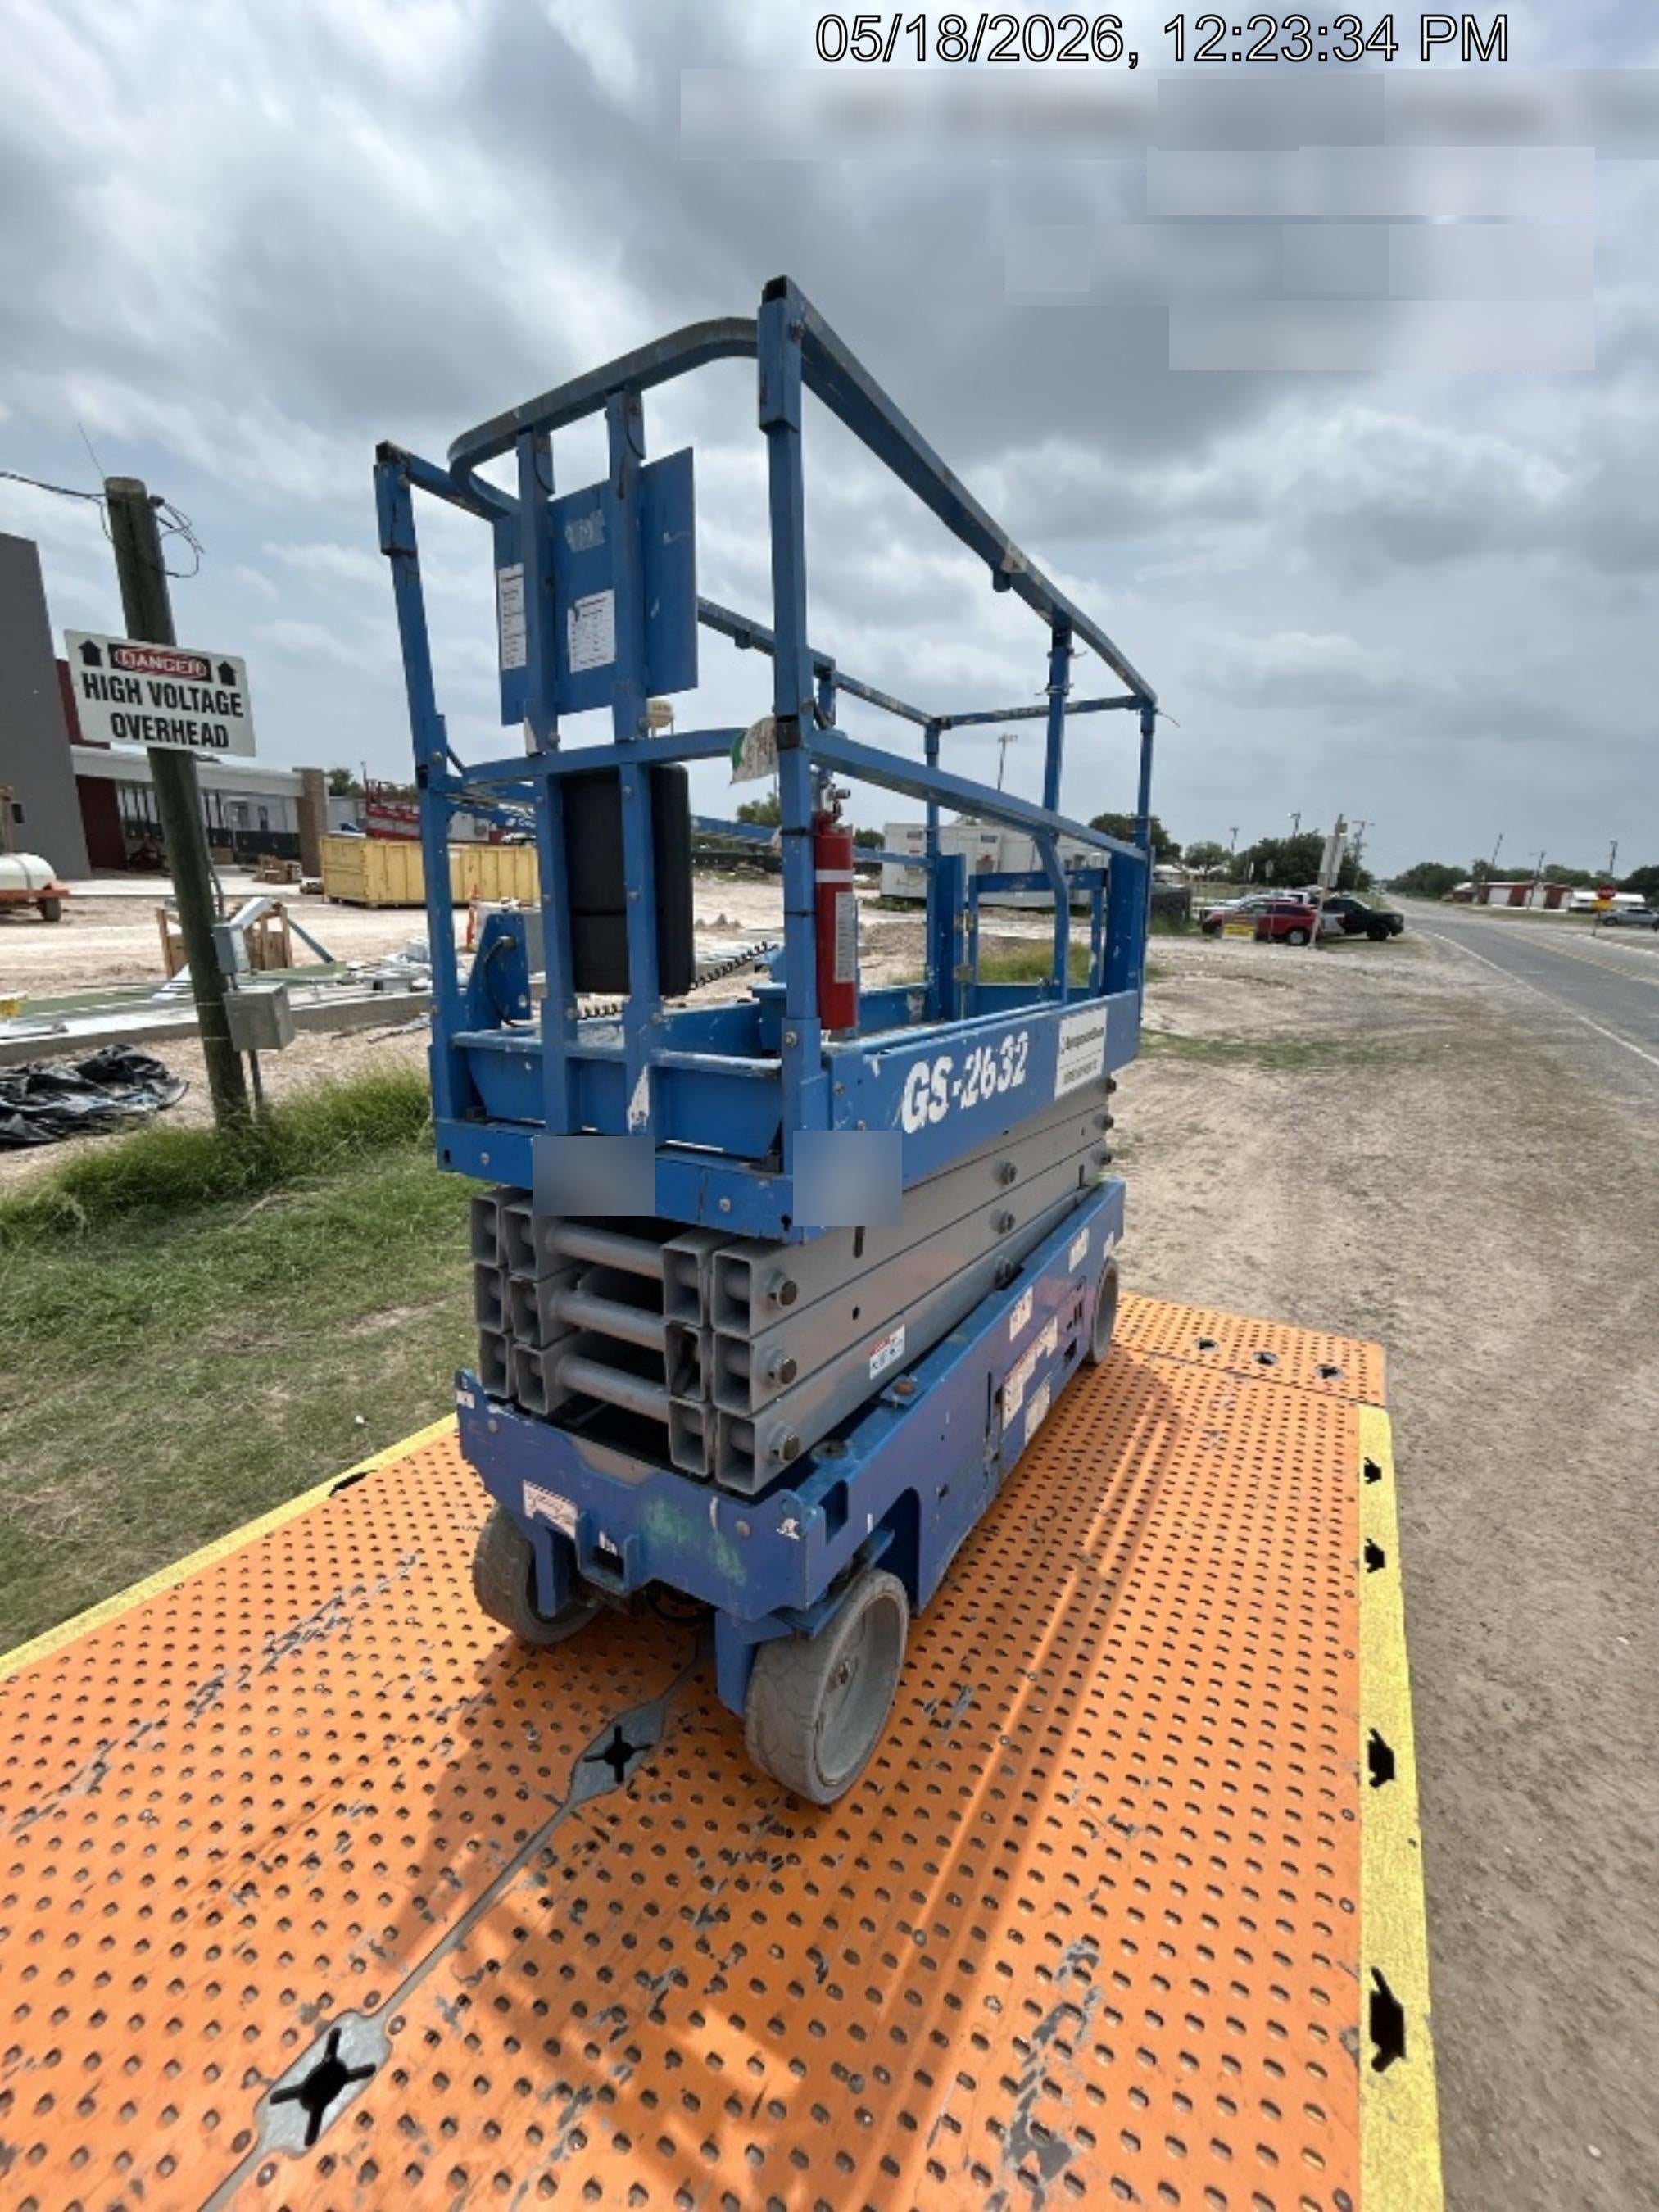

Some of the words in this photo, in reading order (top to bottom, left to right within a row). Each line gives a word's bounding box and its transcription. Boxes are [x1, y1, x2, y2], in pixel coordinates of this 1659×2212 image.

[121, 650, 201, 678] DANGER
[82, 673, 143, 705] HIGH
[148, 682, 243, 717] VOLTAGE
[111, 713, 229, 748] OVERHEAD
[901, 1031, 1029, 1135] GS-2632
